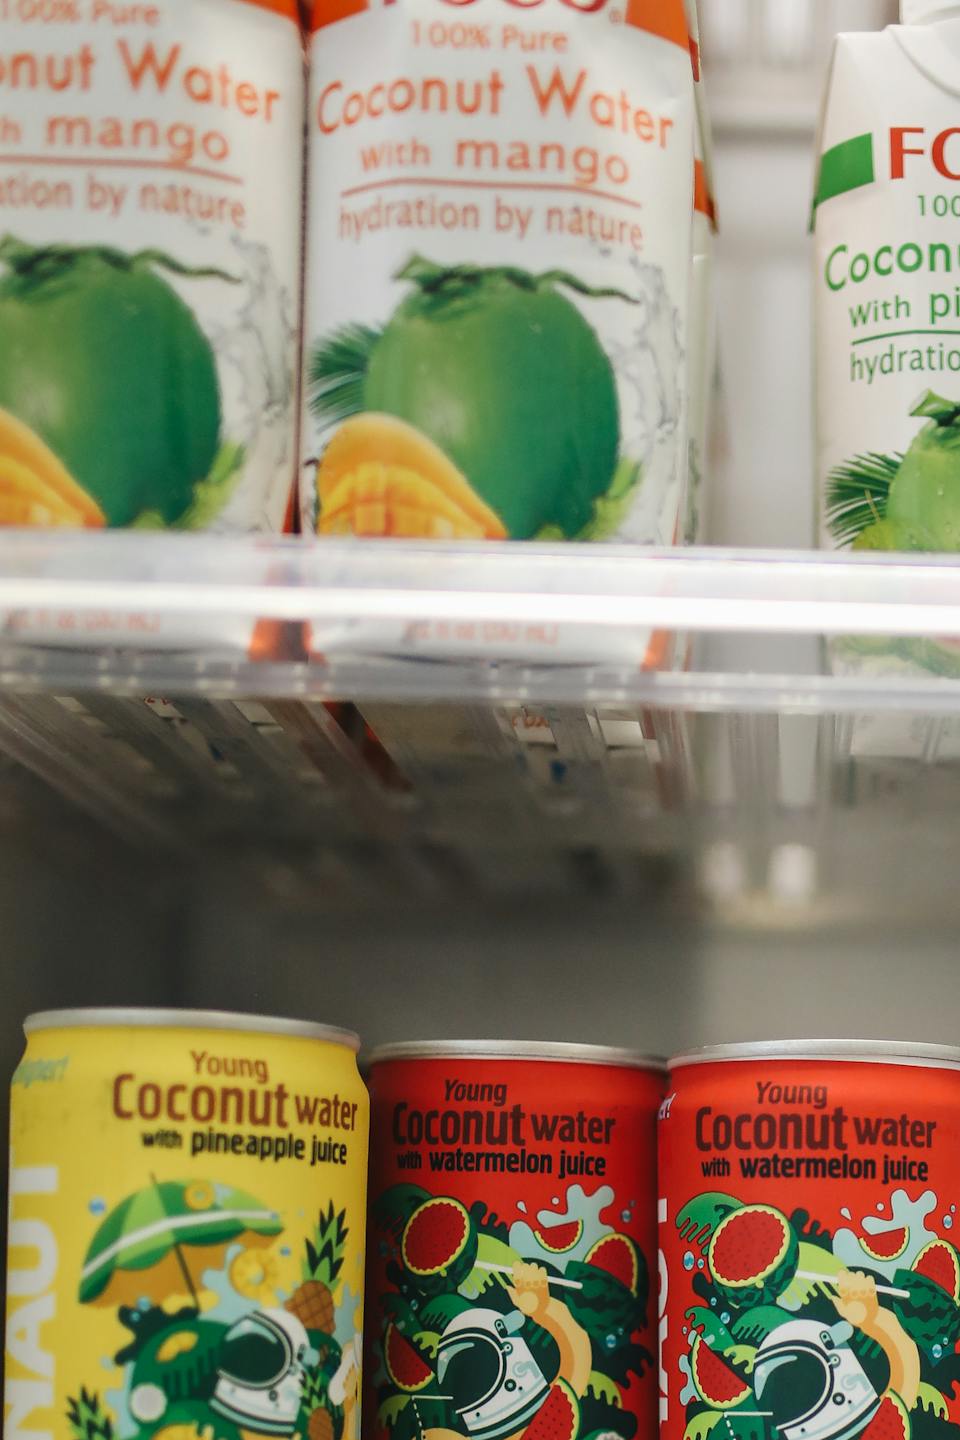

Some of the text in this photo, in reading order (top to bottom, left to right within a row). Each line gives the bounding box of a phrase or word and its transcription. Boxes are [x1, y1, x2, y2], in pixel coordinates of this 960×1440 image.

[410, 19, 569, 51] 100% Pure
[116, 38, 281, 122] Water
[316, 64, 675, 148] Coconut Water
[47, 116, 230, 168] mango
[360, 138, 629, 186] with mango
[87, 172, 127, 217] by
[139, 181, 247, 229] nature
[338, 194, 645, 250] hydration by nature
[849, 295, 911, 327] with
[191, 1051, 269, 1084] Young
[113, 1073, 358, 1131] Coconut water
[445, 1080, 507, 1106] Young
[756, 1081, 828, 1109] Young
[141, 1127, 347, 1165] with pineapple juice
[393, 1103, 616, 1146] Coconut water
[695, 1107, 937, 1151] Coconut water
[397, 1149, 606, 1179] with watermelon juice
[702, 1154, 929, 1184] with watermelon juice
